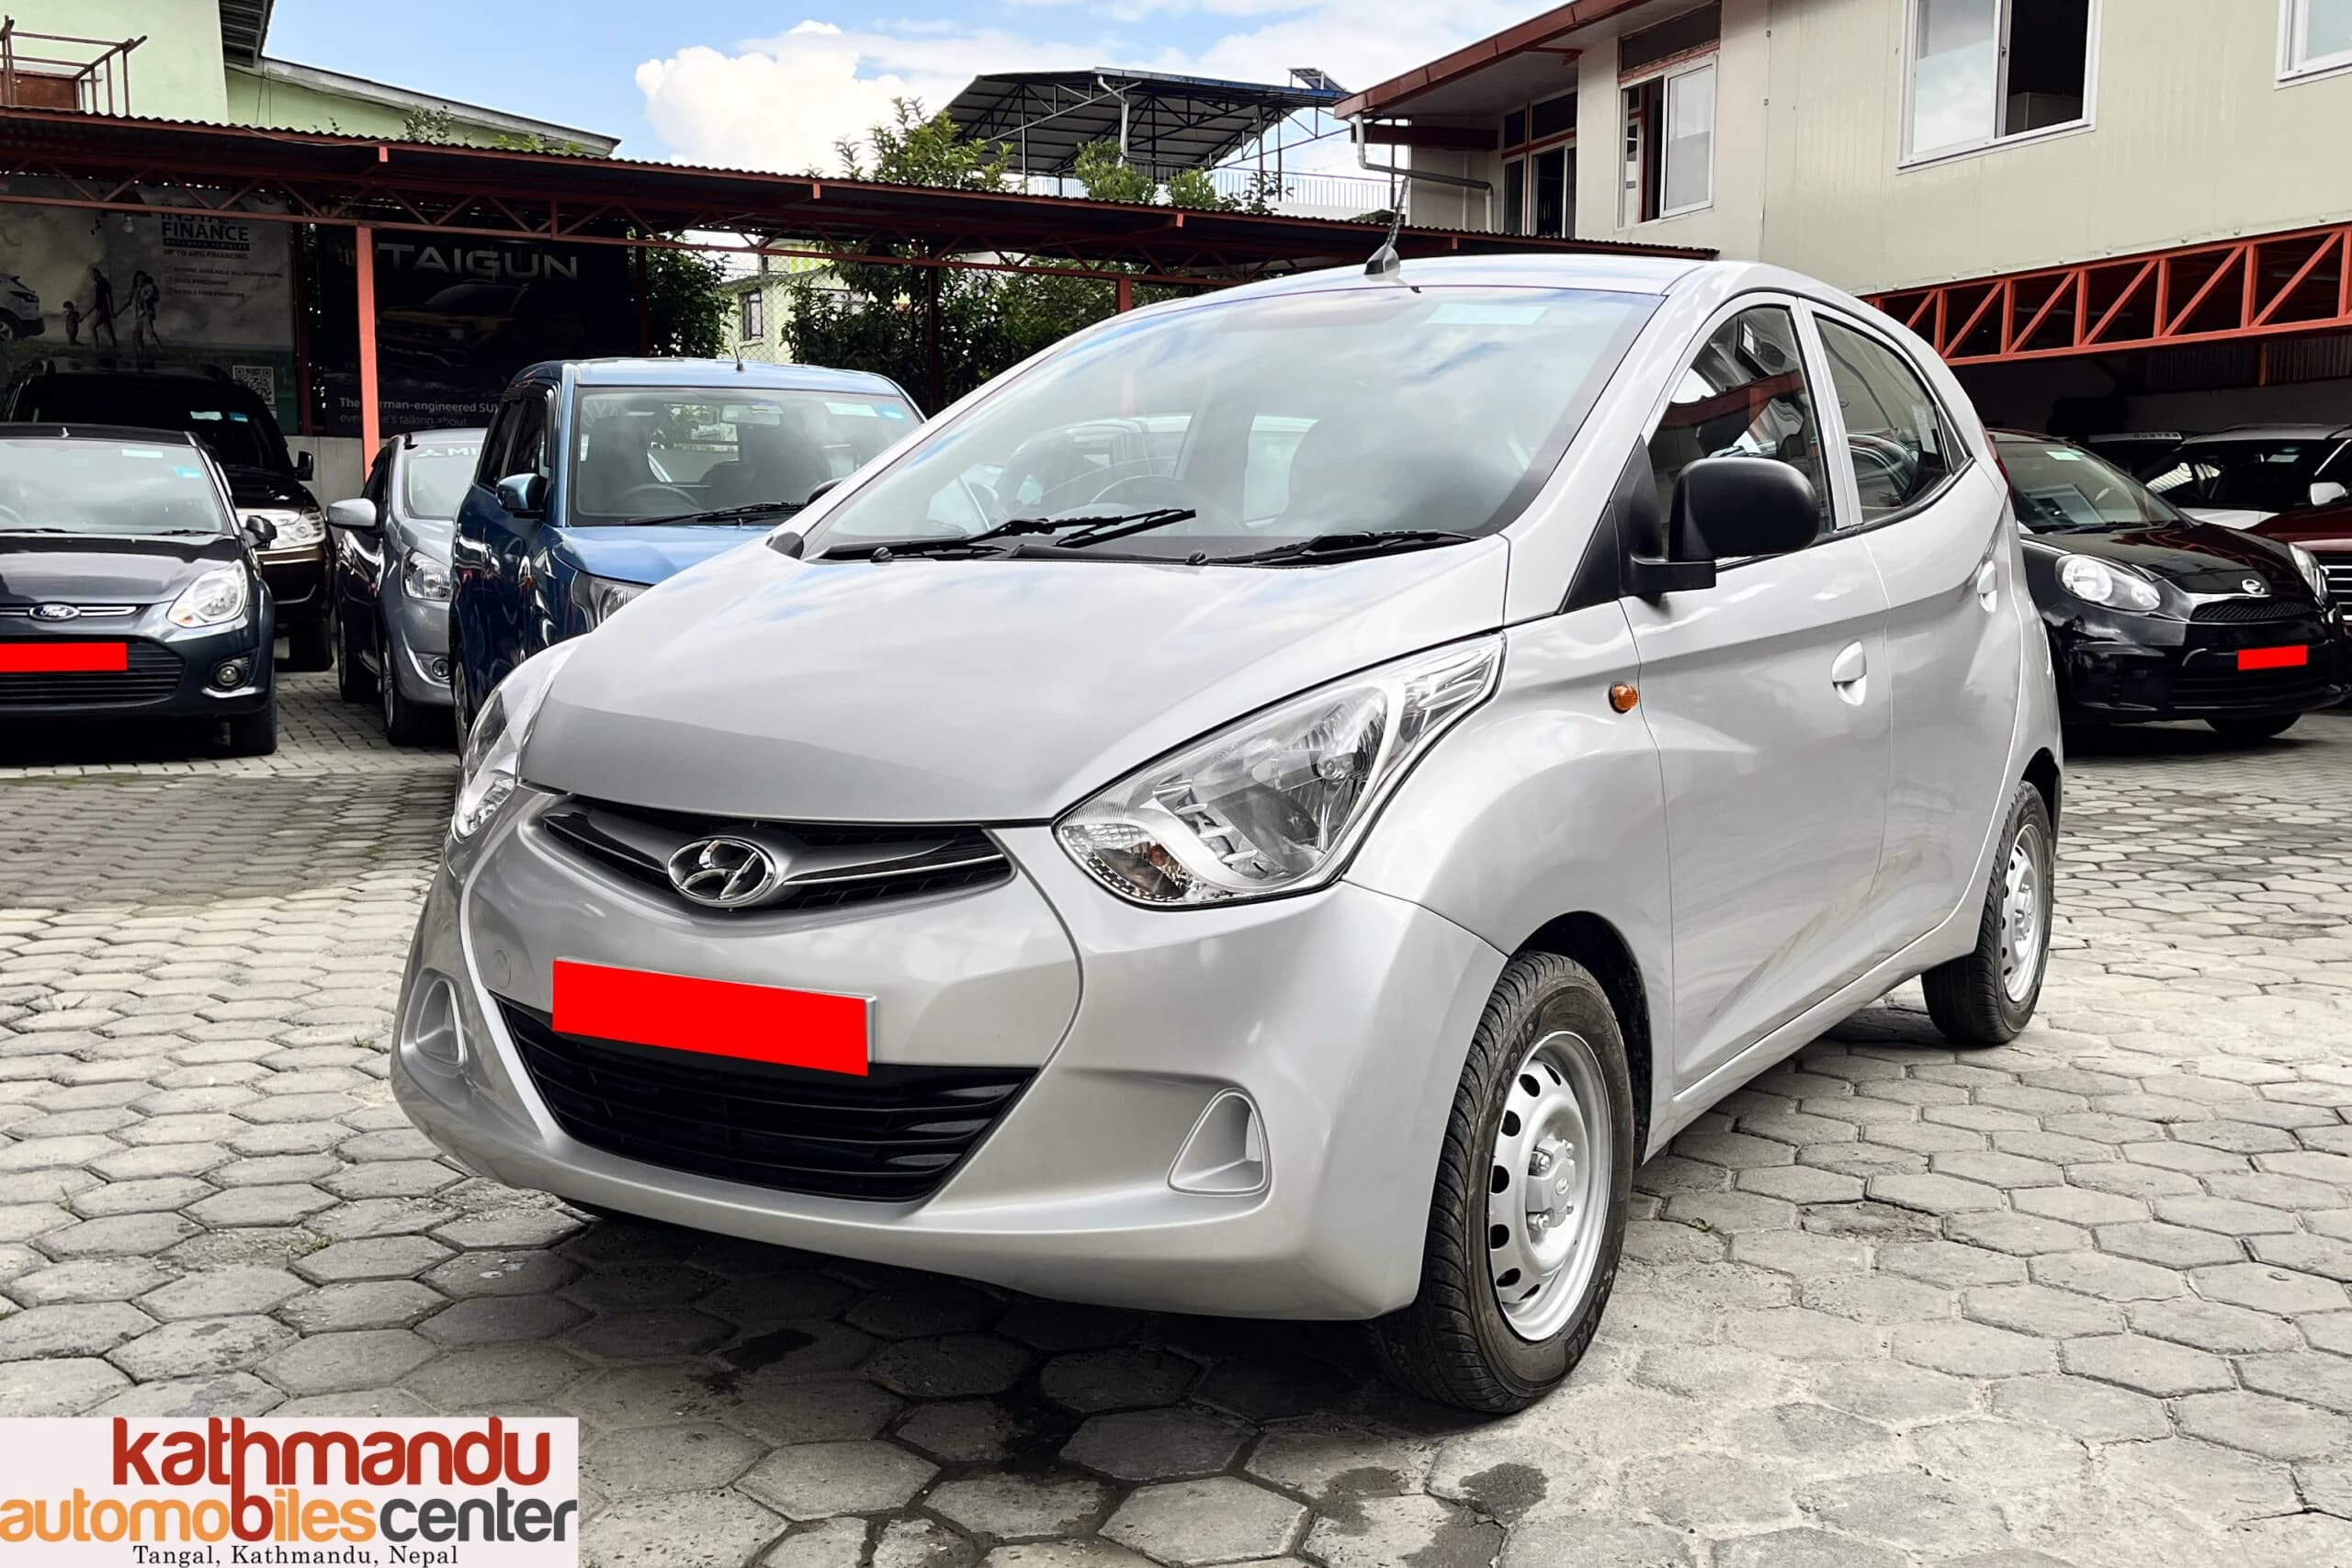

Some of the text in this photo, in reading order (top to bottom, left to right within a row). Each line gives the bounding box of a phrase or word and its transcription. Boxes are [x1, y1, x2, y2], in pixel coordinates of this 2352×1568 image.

[161, 221, 249, 241] FINANCE
[378, 242, 579, 280] TAIGUN
[338, 397, 361, 408] The
[379, 400, 477, 413] rman-engineered
